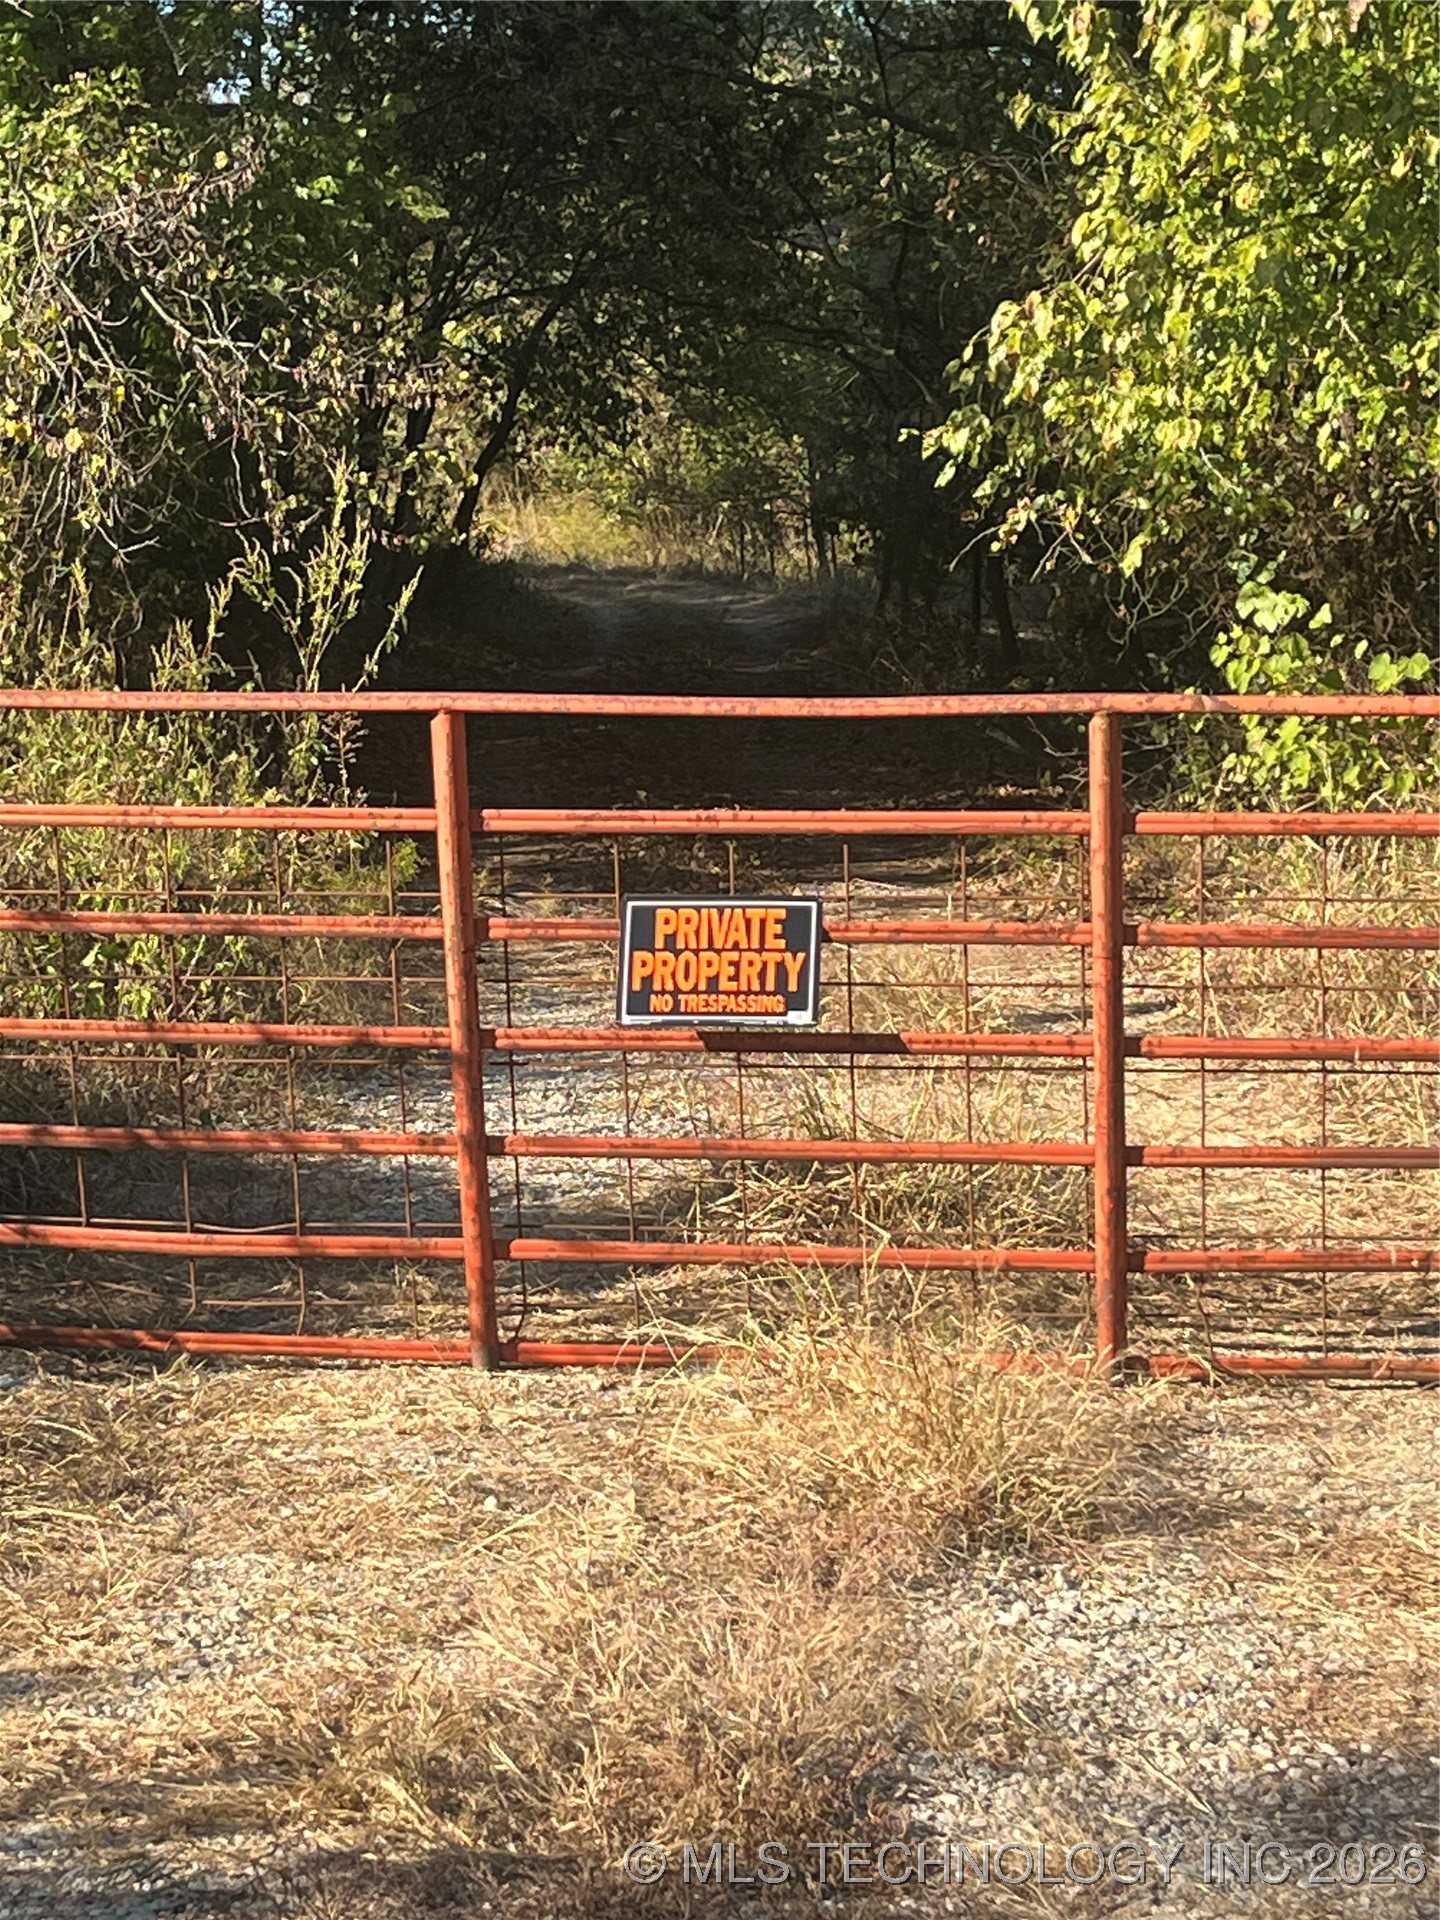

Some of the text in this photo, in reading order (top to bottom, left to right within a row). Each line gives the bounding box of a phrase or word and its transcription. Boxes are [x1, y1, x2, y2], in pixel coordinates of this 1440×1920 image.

[655, 907, 787, 950] PRIVATE
[631, 950, 806, 993] PROPERTY
[649, 993, 786, 1014] NO TRESPASSING
